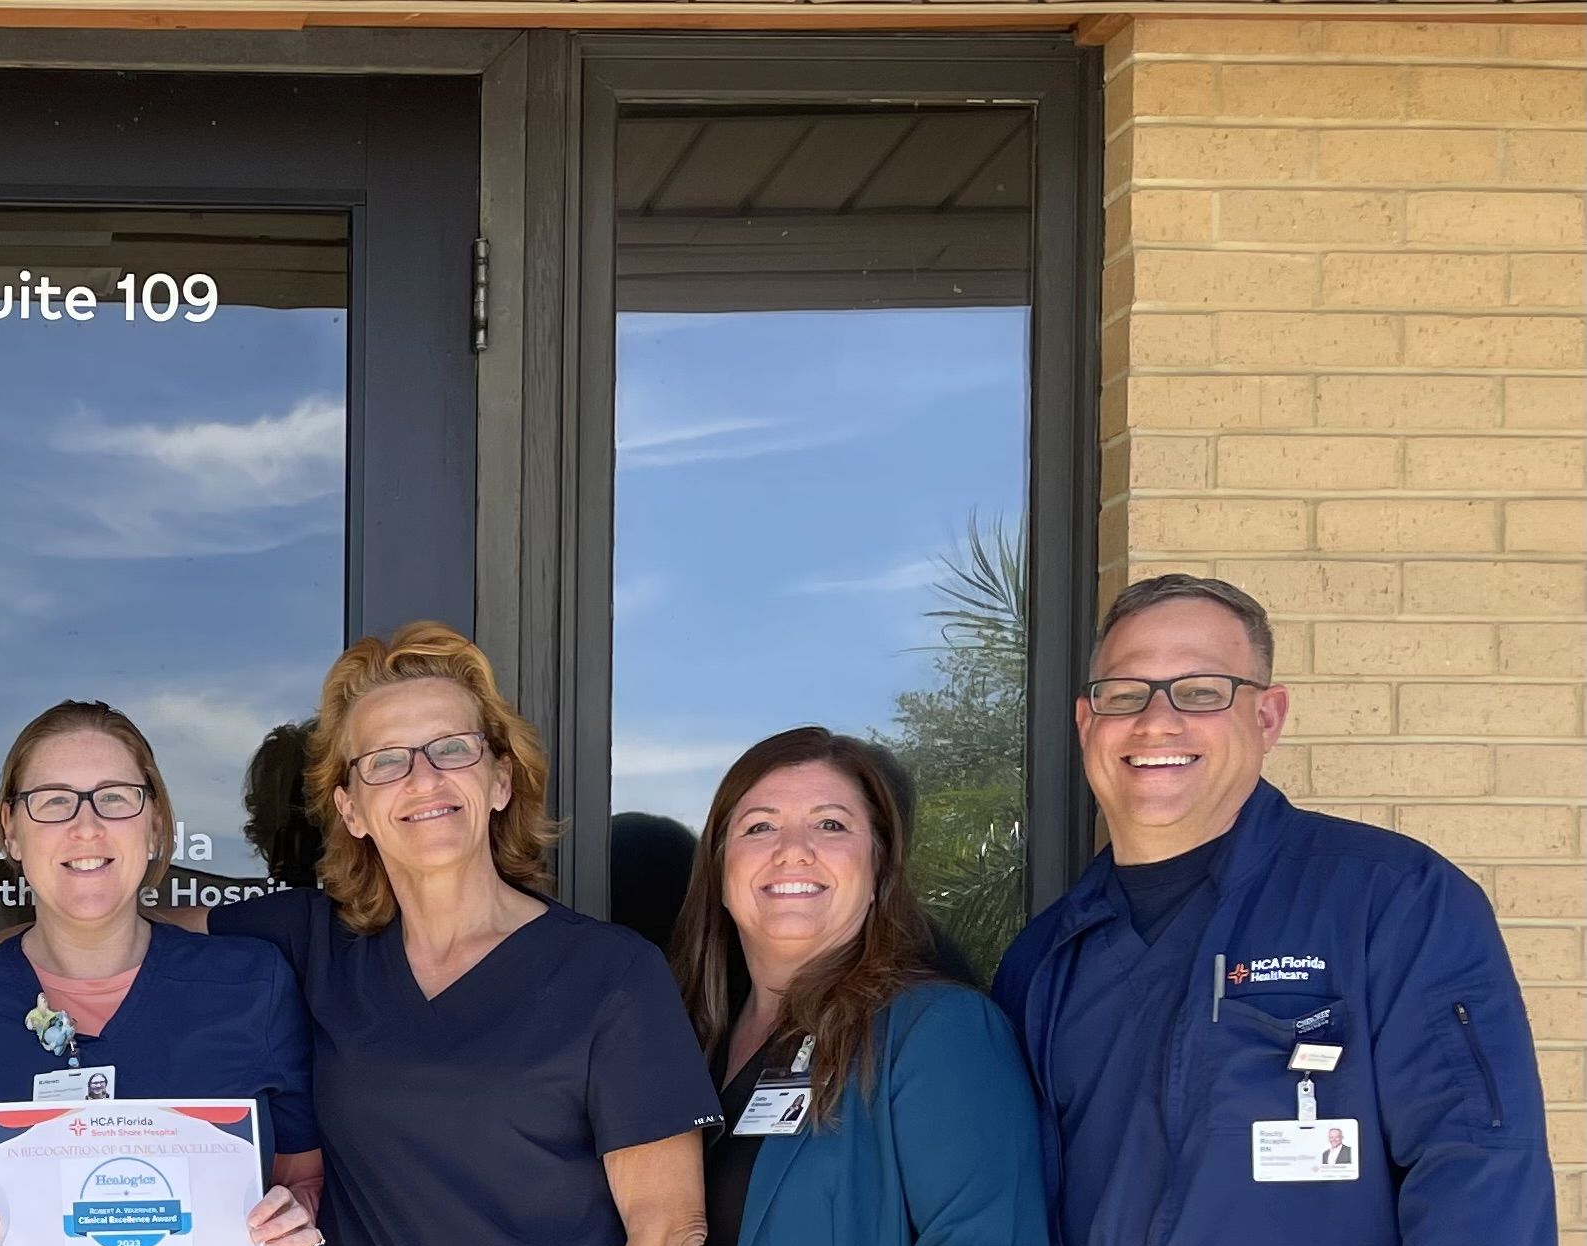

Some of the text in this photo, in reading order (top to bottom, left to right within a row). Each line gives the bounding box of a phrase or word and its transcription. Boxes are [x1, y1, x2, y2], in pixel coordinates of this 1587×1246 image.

[116, 272, 219, 324] 109
[1251, 955, 1326, 972] HCA Florida
[1249, 969, 1309, 982] Healthcare
[90, 1116, 154, 1127] HCA Florida
[90, 1127, 178, 1137] South Shore Hospital
[171, 1143, 241, 1154] EXCELLENCE
[95, 1174, 156, 1187] Healogics
[78, 1215, 108, 1225] Clinical
